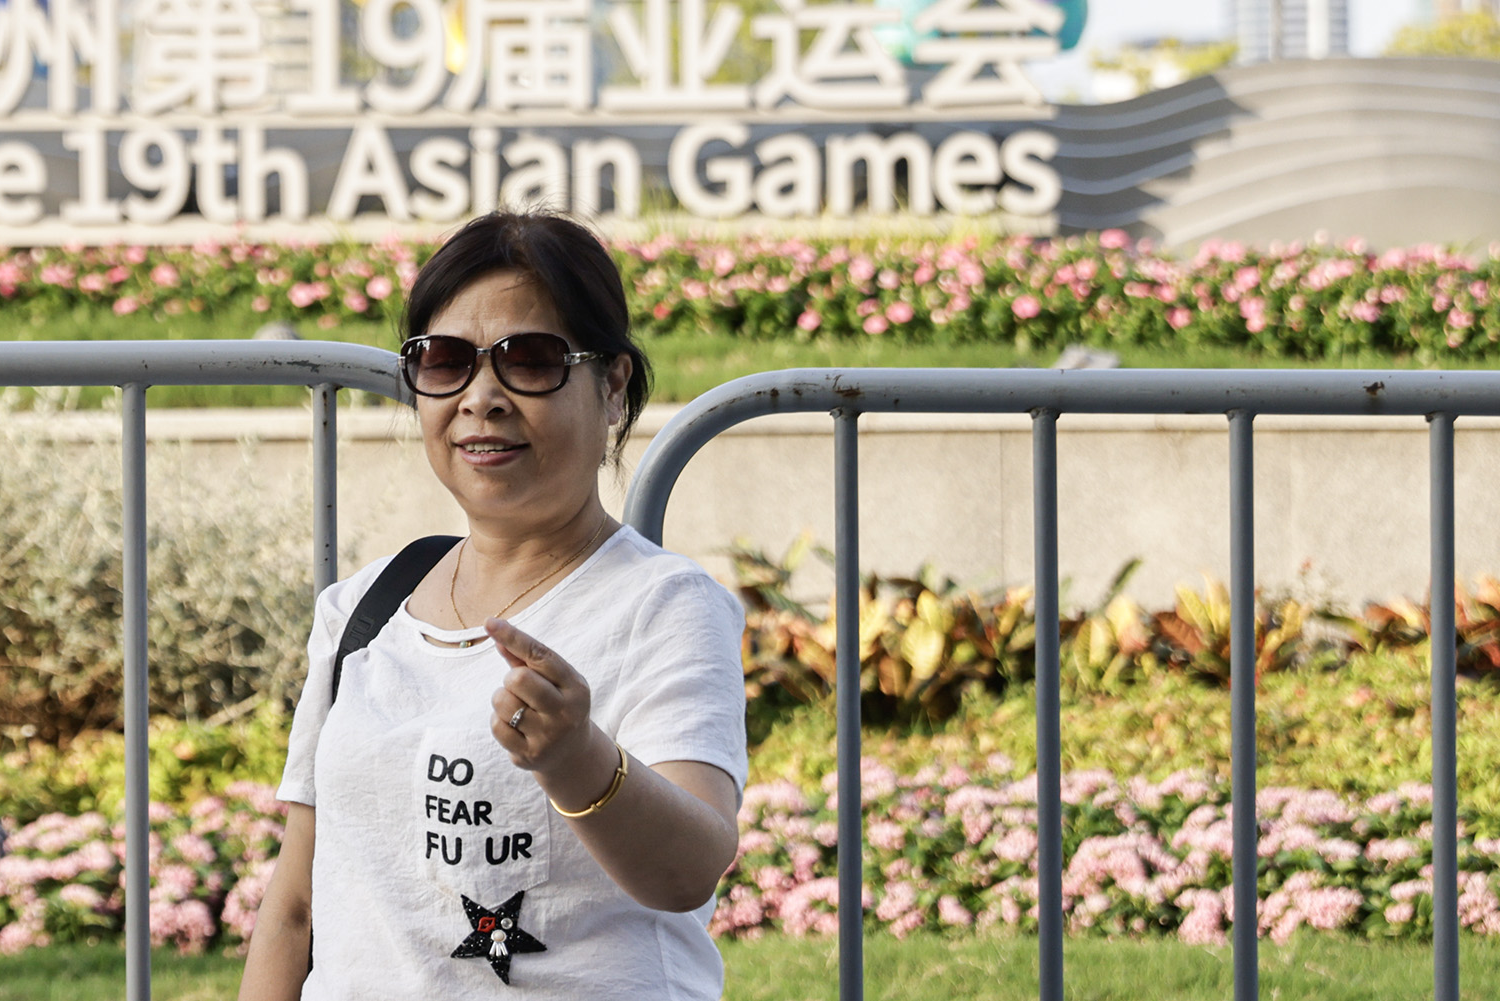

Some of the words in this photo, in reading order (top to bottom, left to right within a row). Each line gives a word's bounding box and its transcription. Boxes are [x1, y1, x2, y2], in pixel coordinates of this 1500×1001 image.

[60, 125, 309, 224] 19th
[326, 120, 641, 221] Asian
[667, 119, 1062, 218] Games
[427, 753, 474, 786] DO
[425, 794, 493, 826] FEAR
